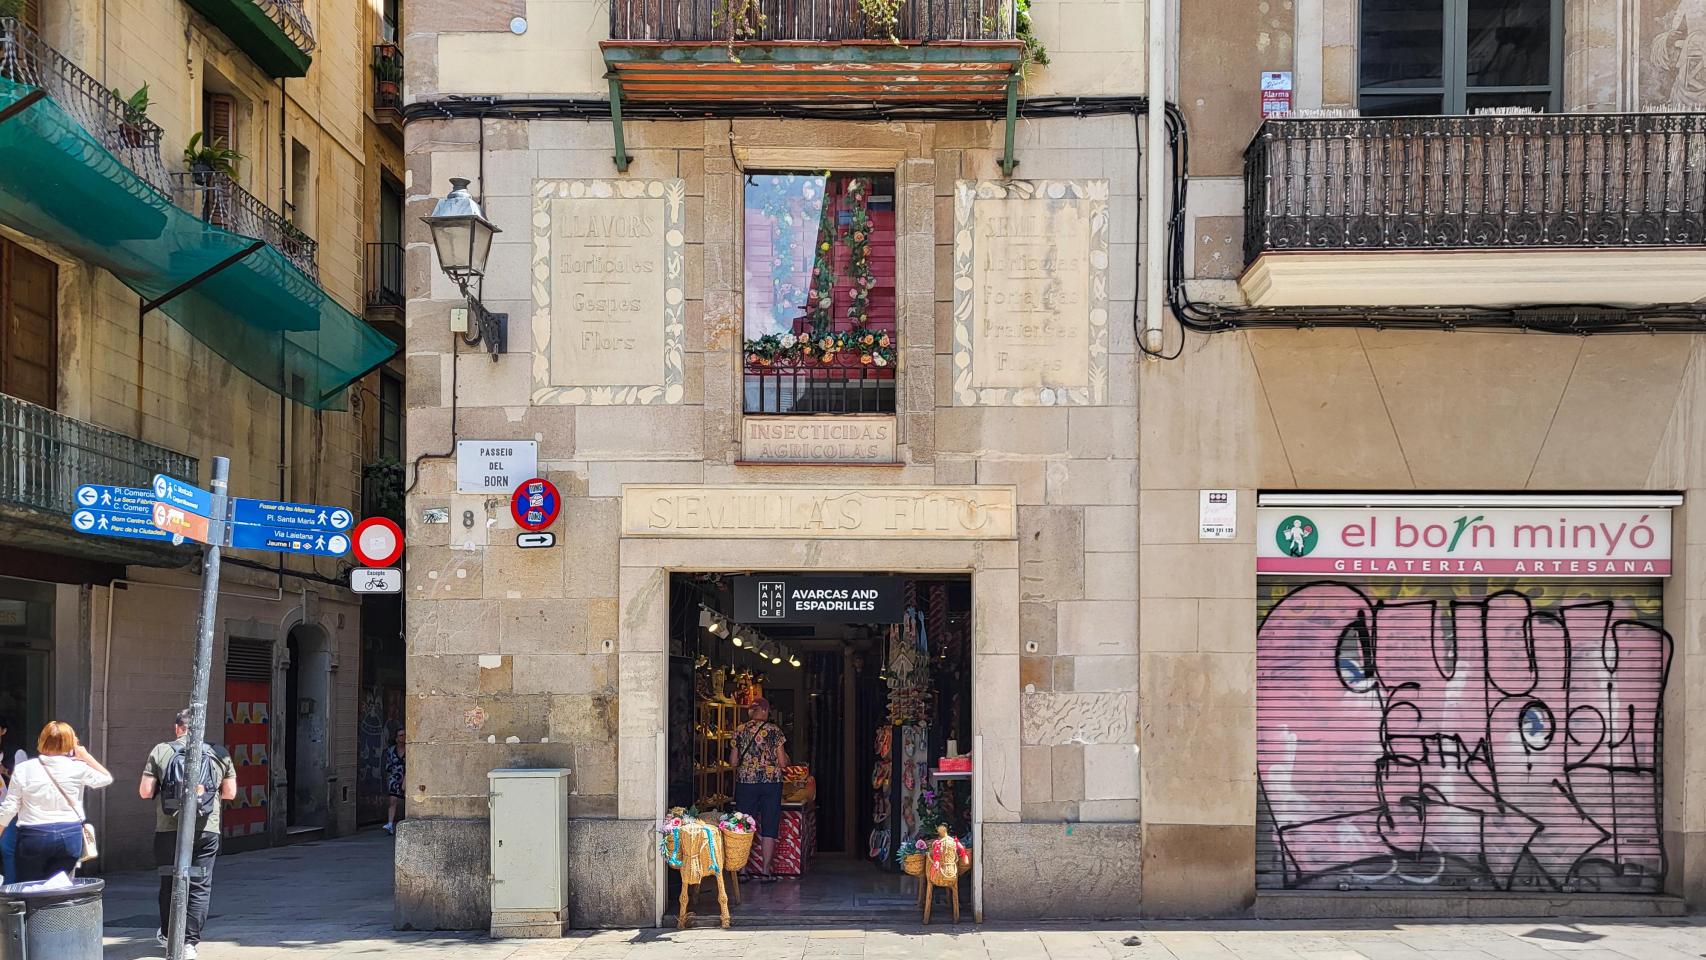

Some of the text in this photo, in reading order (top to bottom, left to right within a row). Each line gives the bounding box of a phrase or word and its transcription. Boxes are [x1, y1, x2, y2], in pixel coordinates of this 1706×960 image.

[560, 215, 655, 238] LLAVORS
[560, 254, 653, 274] Horticoles
[573, 293, 641, 316] Gespes
[581, 331, 636, 351] Flors
[750, 424, 888, 440] INSECTICIDAS
[480, 448, 513, 457] PASSEIG
[489, 462, 504, 470] DEL
[484, 476, 509, 487] BORN
[113, 502, 150, 513] C. Comerç
[648, 495, 863, 530] SEMILLAS
[277, 515, 296, 523] Santa
[297, 516, 315, 524] Maria
[462, 510, 474, 528] 8
[274, 530, 314, 540] Via Laietana
[1341, 514, 1655, 556] el born minyó
[1335, 559, 1654, 572] GELATERIA ARTESANA
[792, 589, 879, 600] AVARCAS AND
[795, 601, 875, 611] ESPADRILLES
